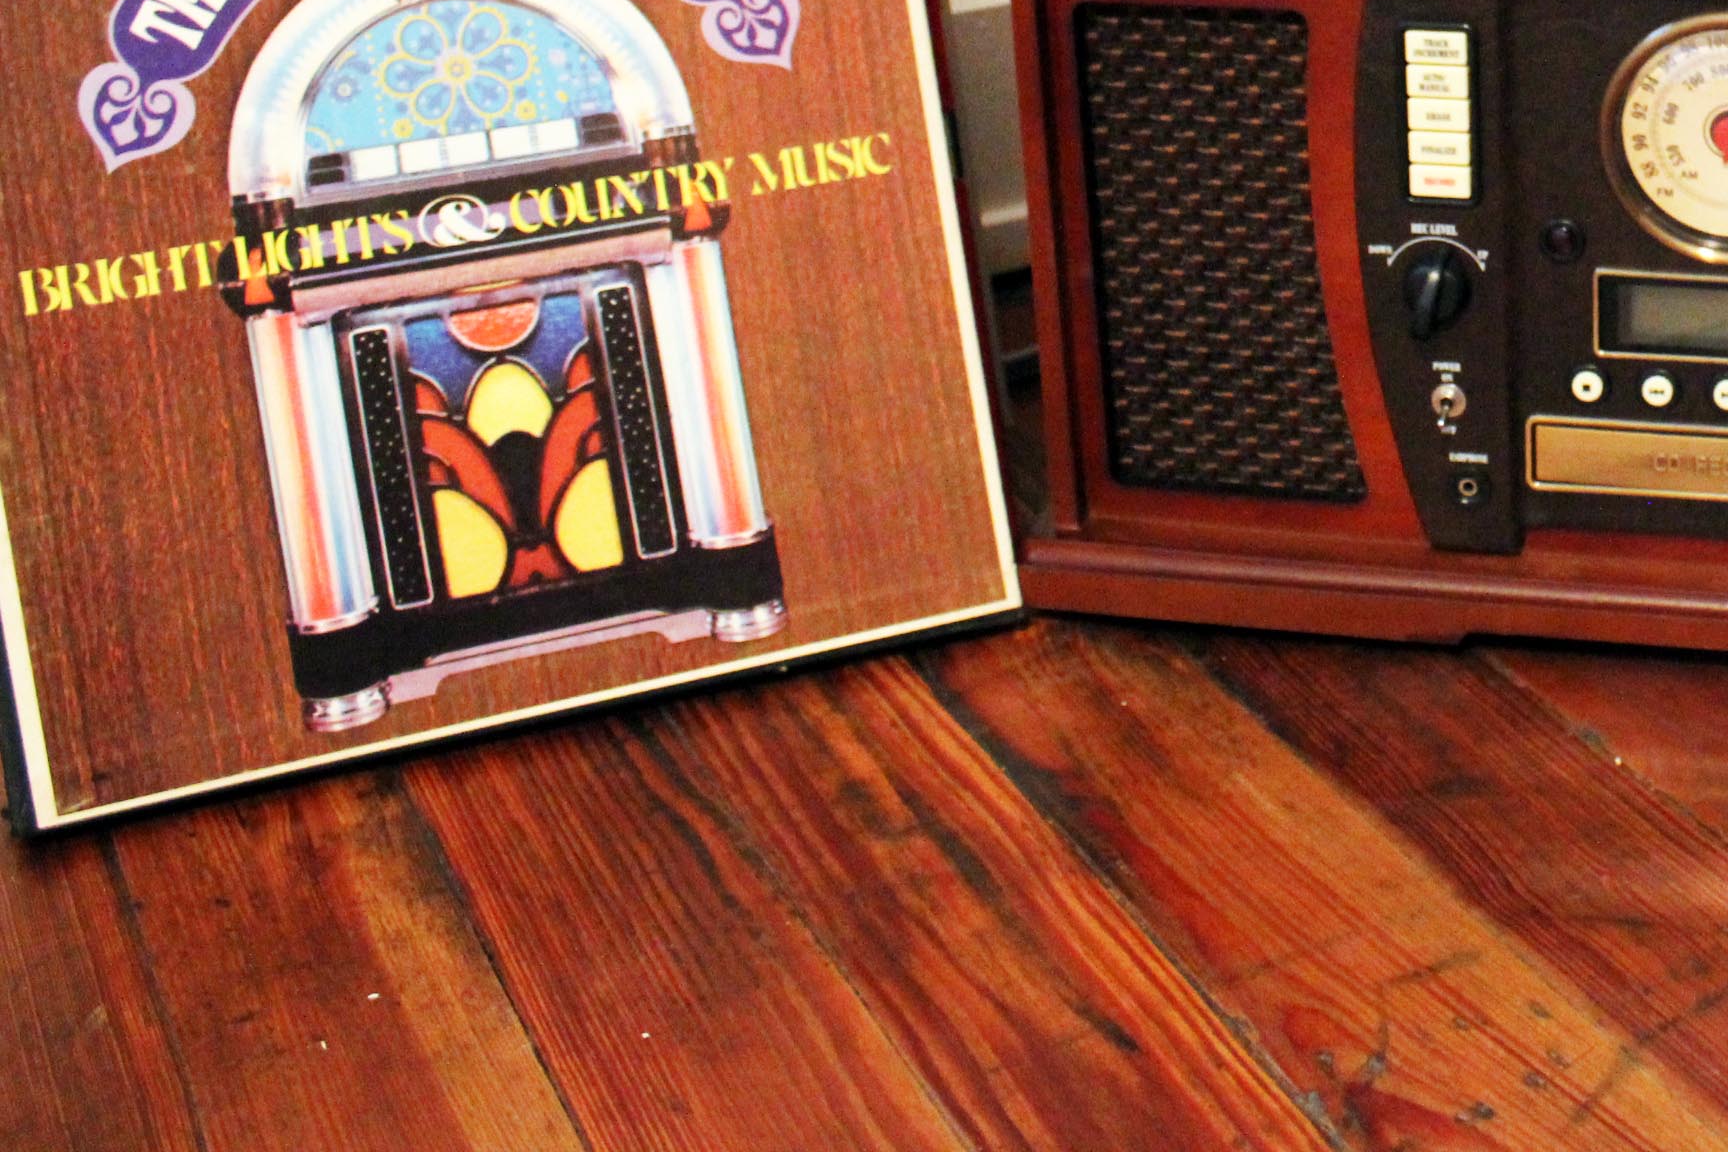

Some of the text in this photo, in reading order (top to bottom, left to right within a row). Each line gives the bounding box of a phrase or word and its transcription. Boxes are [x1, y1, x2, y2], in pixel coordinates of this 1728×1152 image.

[1631, 102, 1648, 121] 92
[1656, 188, 1675, 199] FM
[19, 132, 892, 316] BRIGHT LIGHTS & COUNTRY MUSIC
